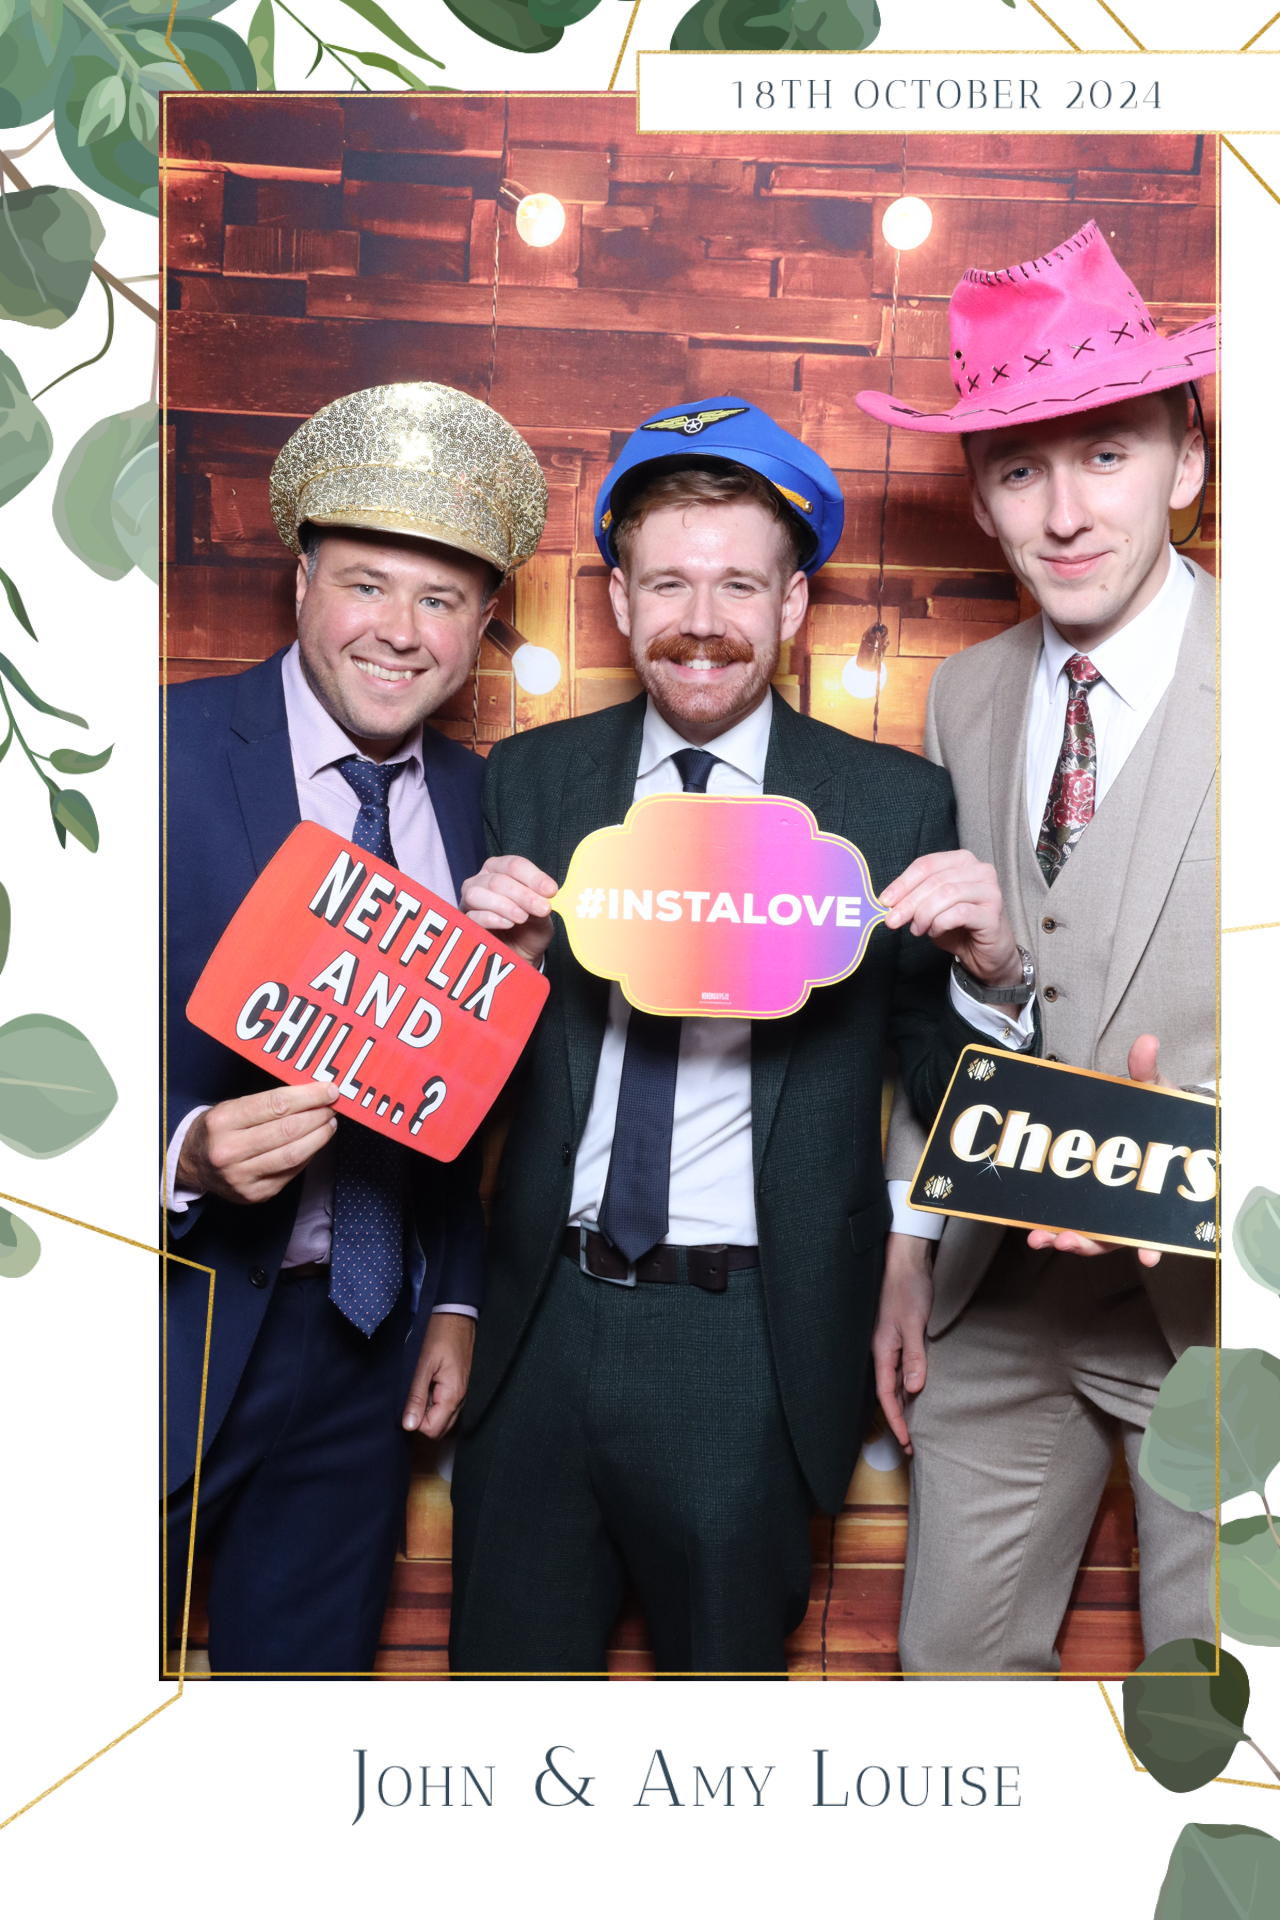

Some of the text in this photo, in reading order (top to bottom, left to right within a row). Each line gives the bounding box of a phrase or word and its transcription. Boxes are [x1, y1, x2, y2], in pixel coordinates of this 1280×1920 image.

[308, 850, 516, 1021] NETFLIX
[576, 887, 862, 927] #INSTALOVE
[309, 949, 443, 1048] AND
[949, 1104, 1221, 1203] Cheers
